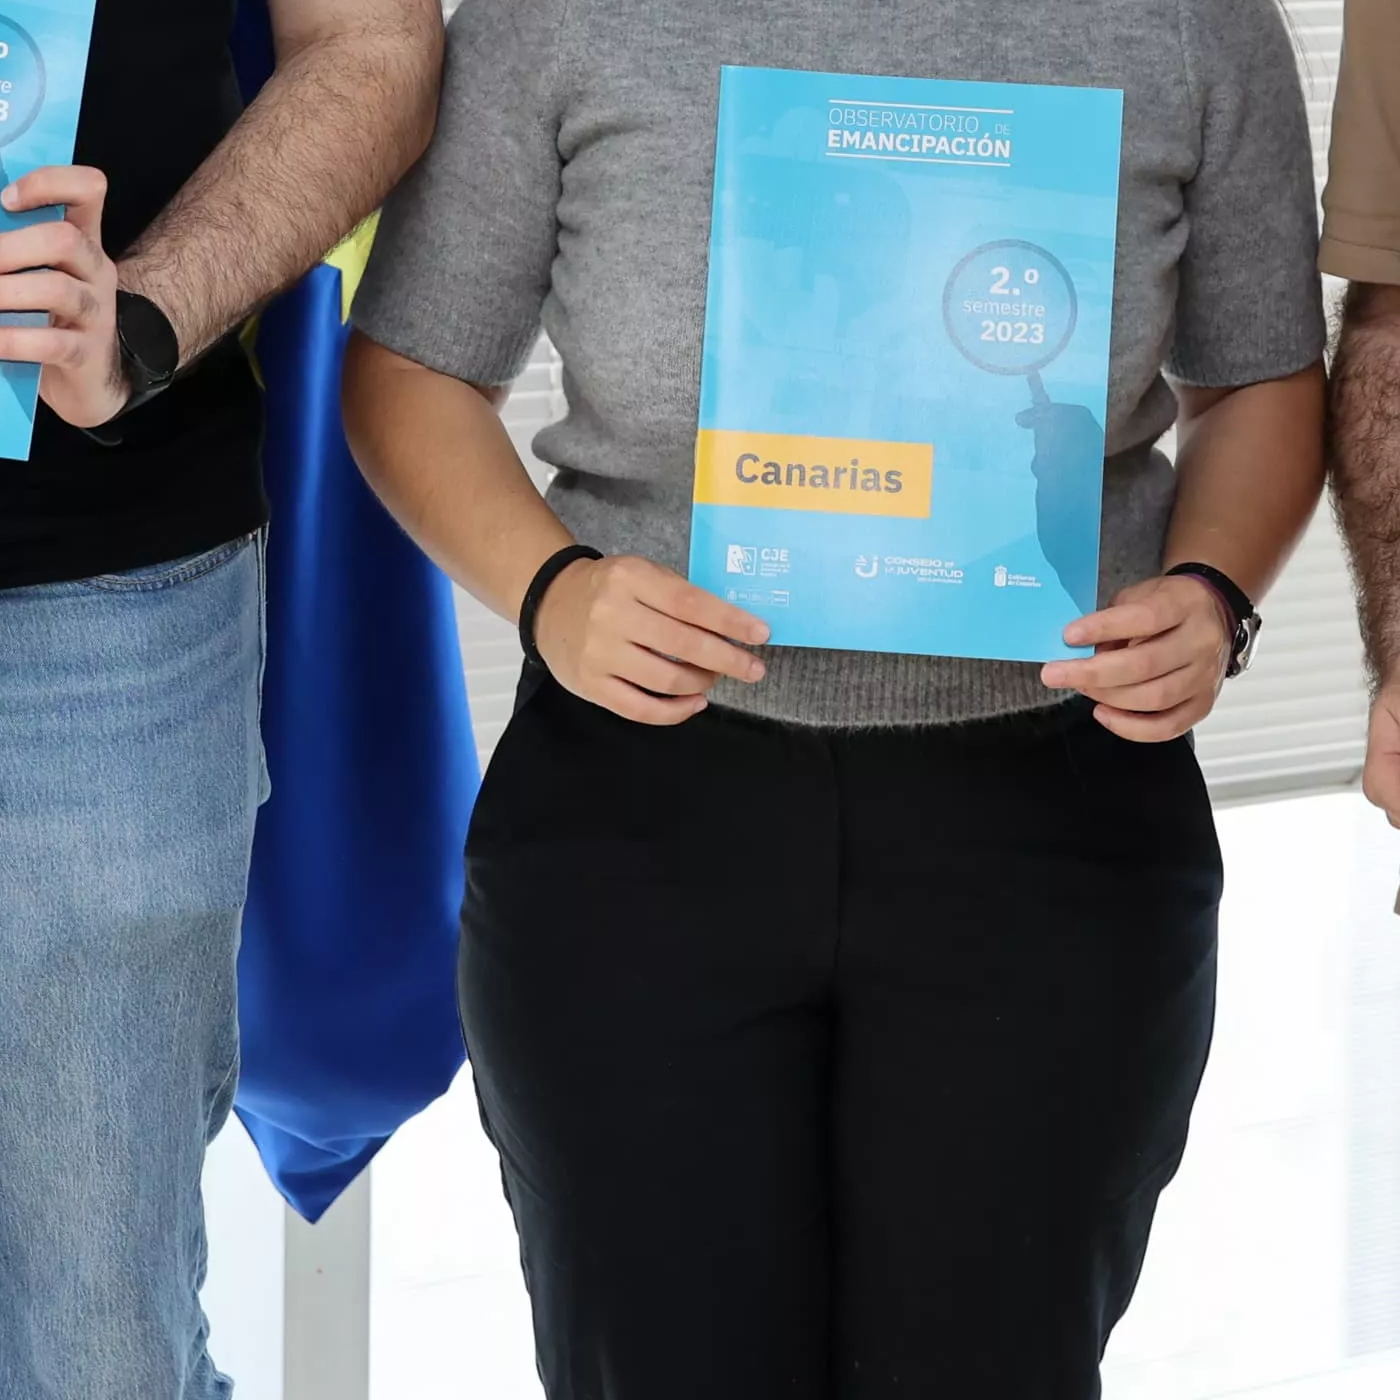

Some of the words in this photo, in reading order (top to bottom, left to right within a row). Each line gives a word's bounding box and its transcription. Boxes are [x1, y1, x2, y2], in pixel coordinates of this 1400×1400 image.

[828, 108, 979, 133] OBSERVATORIO
[994, 123, 1011, 135] DE
[828, 129, 1011, 158] EMANCIPACIÓN
[962, 300, 1046, 317] semestre
[980, 320, 1044, 344] 2023
[735, 453, 902, 493] Canarias
[761, 548, 789, 562] CJE
[897, 567, 964, 578] JUVENTUD
